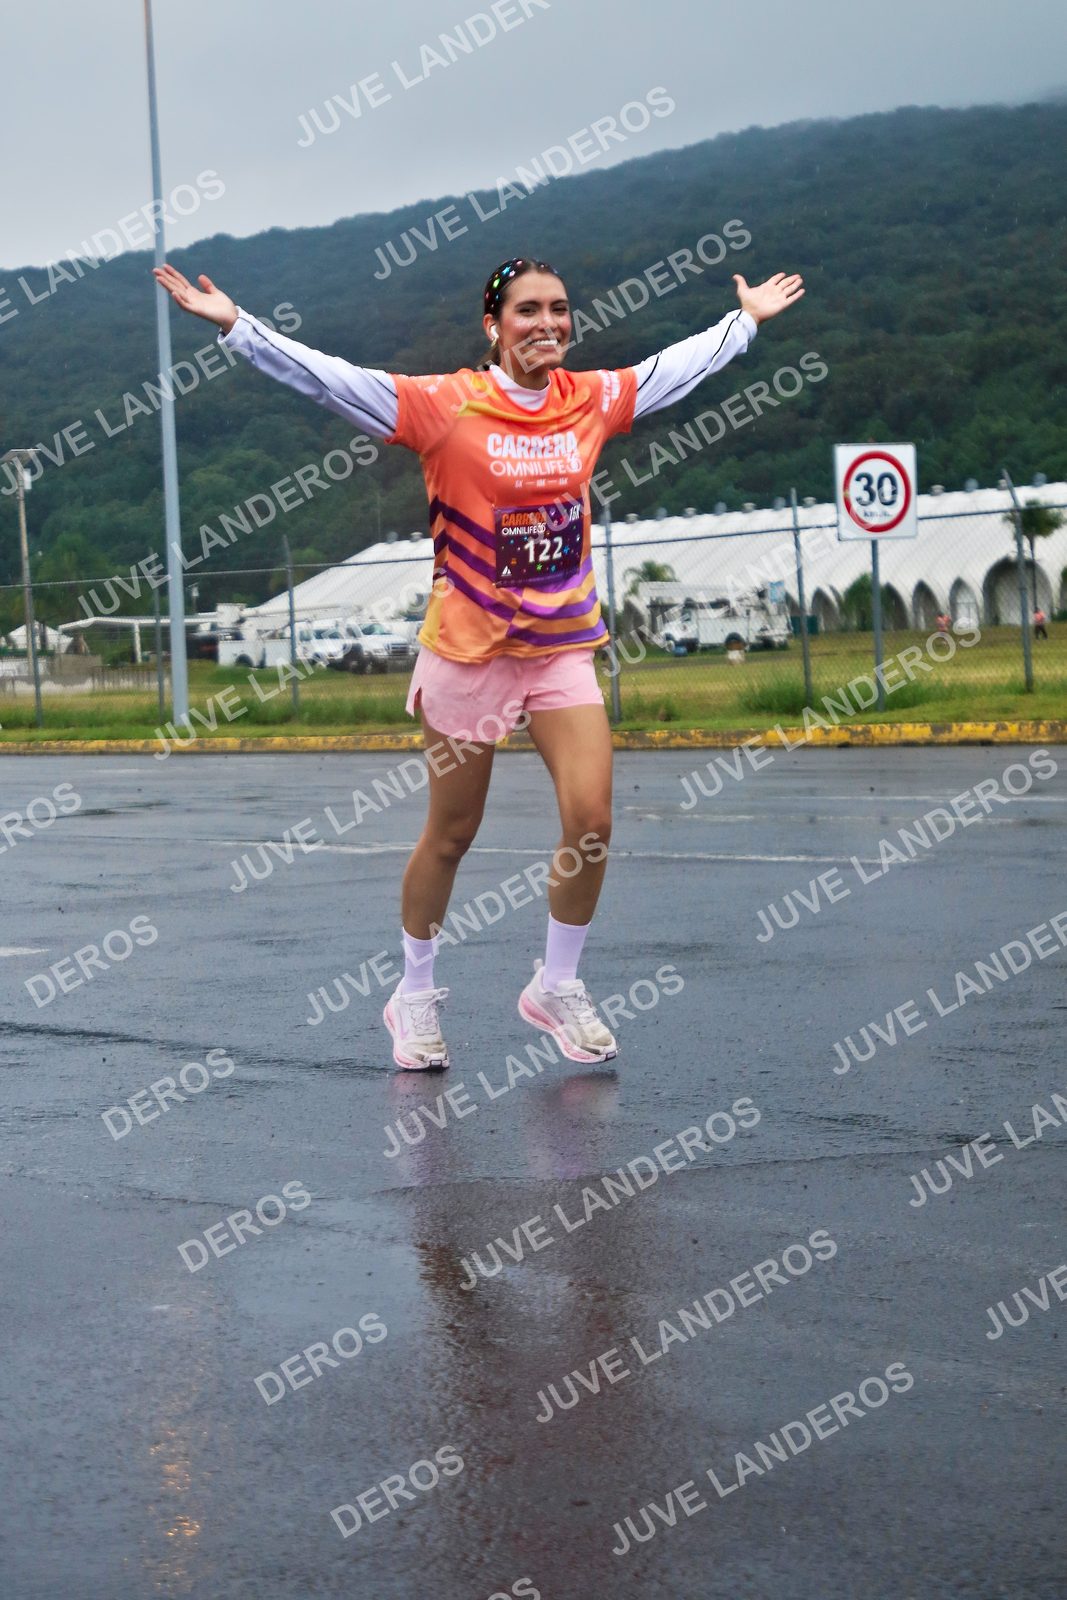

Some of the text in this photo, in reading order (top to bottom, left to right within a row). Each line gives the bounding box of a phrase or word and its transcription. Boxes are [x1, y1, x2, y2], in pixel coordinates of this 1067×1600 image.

[487, 431, 579, 459] CARRERA
[489, 458, 567, 477] OMNILIFE
[854, 471, 899, 507] 30
[501, 525, 538, 536] OMNILIFE
[523, 536, 563, 564] 122
